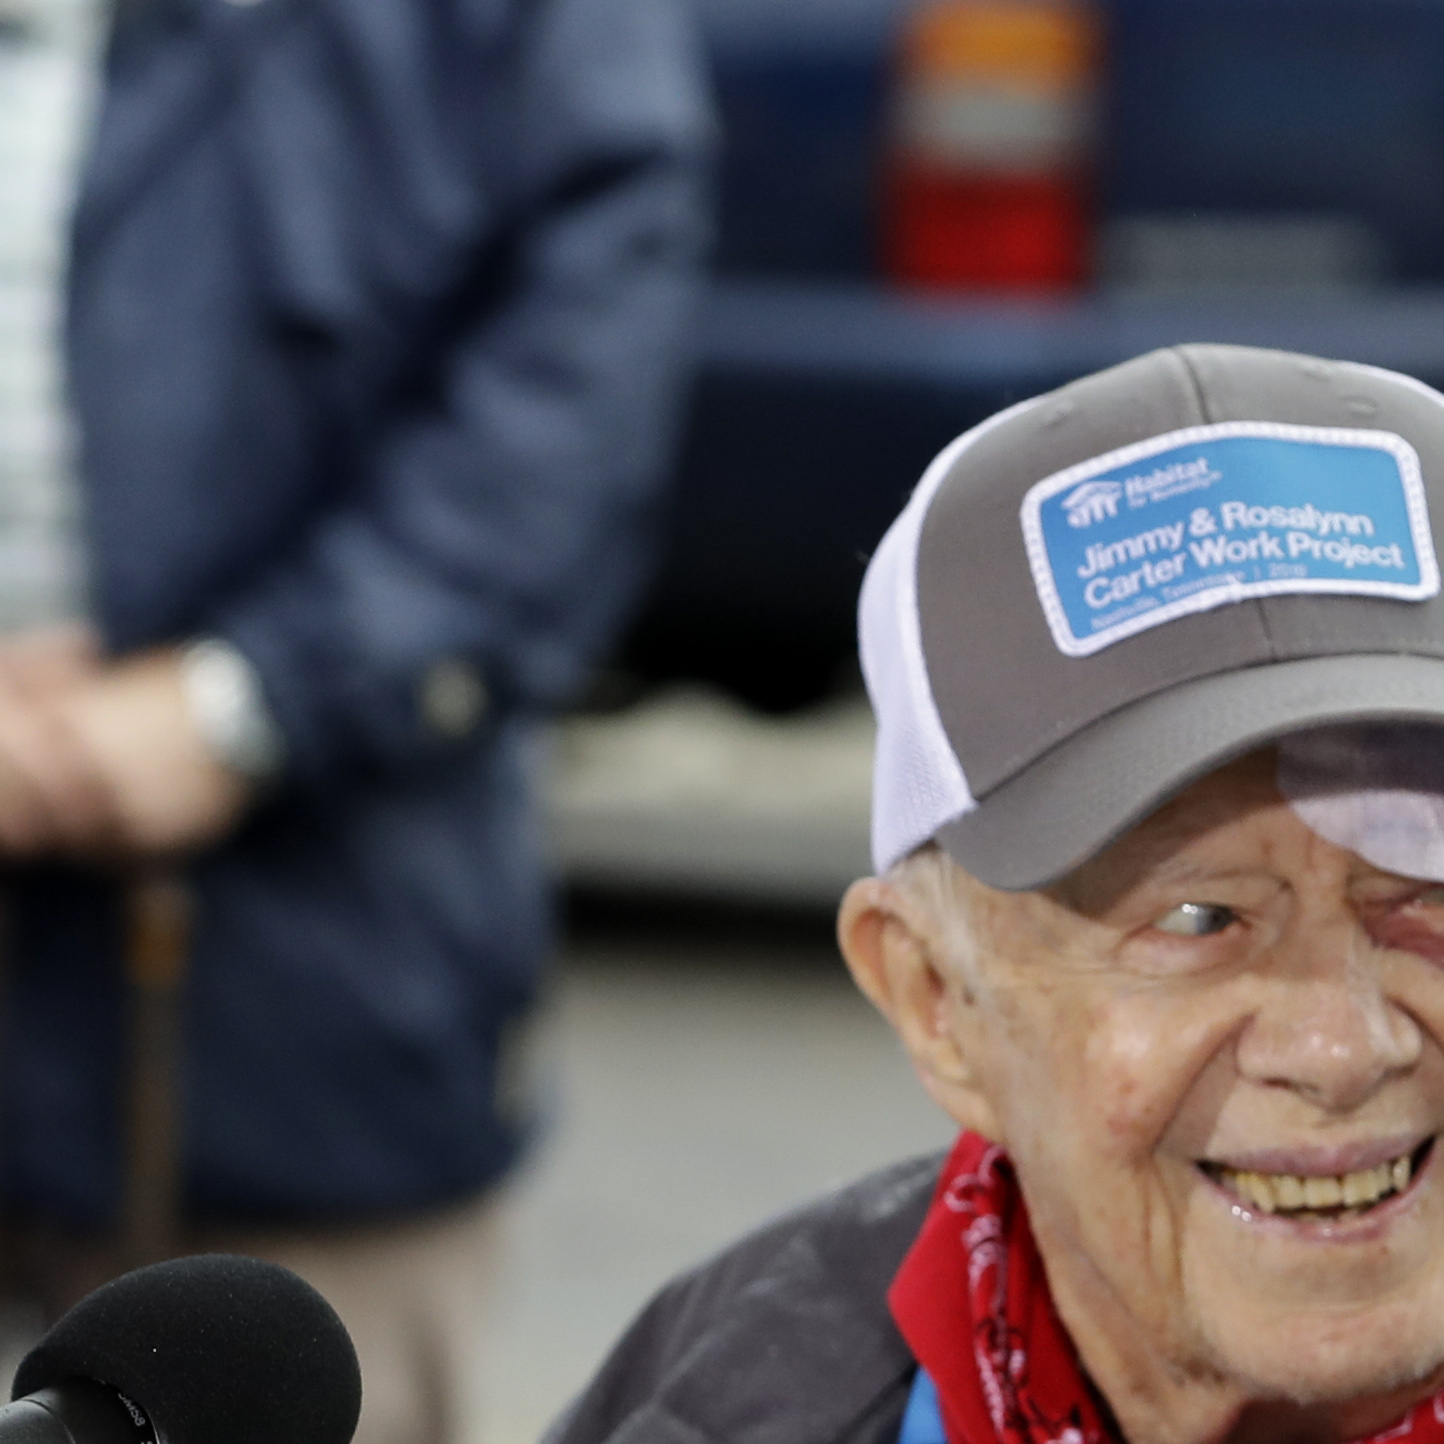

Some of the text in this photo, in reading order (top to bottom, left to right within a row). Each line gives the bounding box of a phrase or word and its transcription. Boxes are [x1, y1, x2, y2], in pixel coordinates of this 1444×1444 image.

[1077, 500, 1375, 580] Jimmy & Rosalynn
[1083, 530, 1406, 609] Carter Work Project
